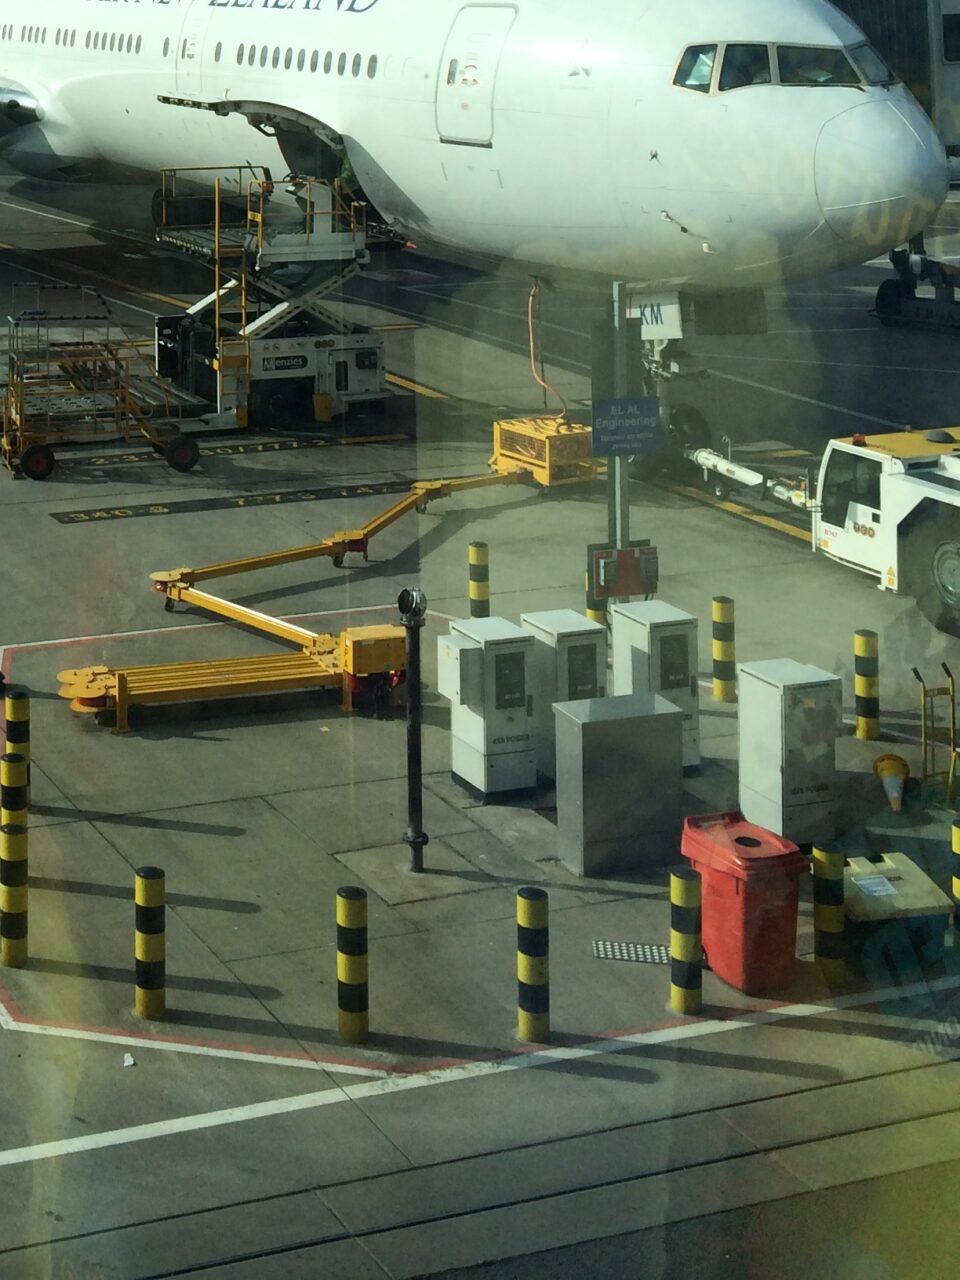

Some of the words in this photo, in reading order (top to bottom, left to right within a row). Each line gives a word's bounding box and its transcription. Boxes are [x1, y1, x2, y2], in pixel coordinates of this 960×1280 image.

[639, 303, 664, 325] KM
[610, 405, 625, 415] EL
[626, 404, 641, 414] AL
[595, 416, 657, 430] Engineering
